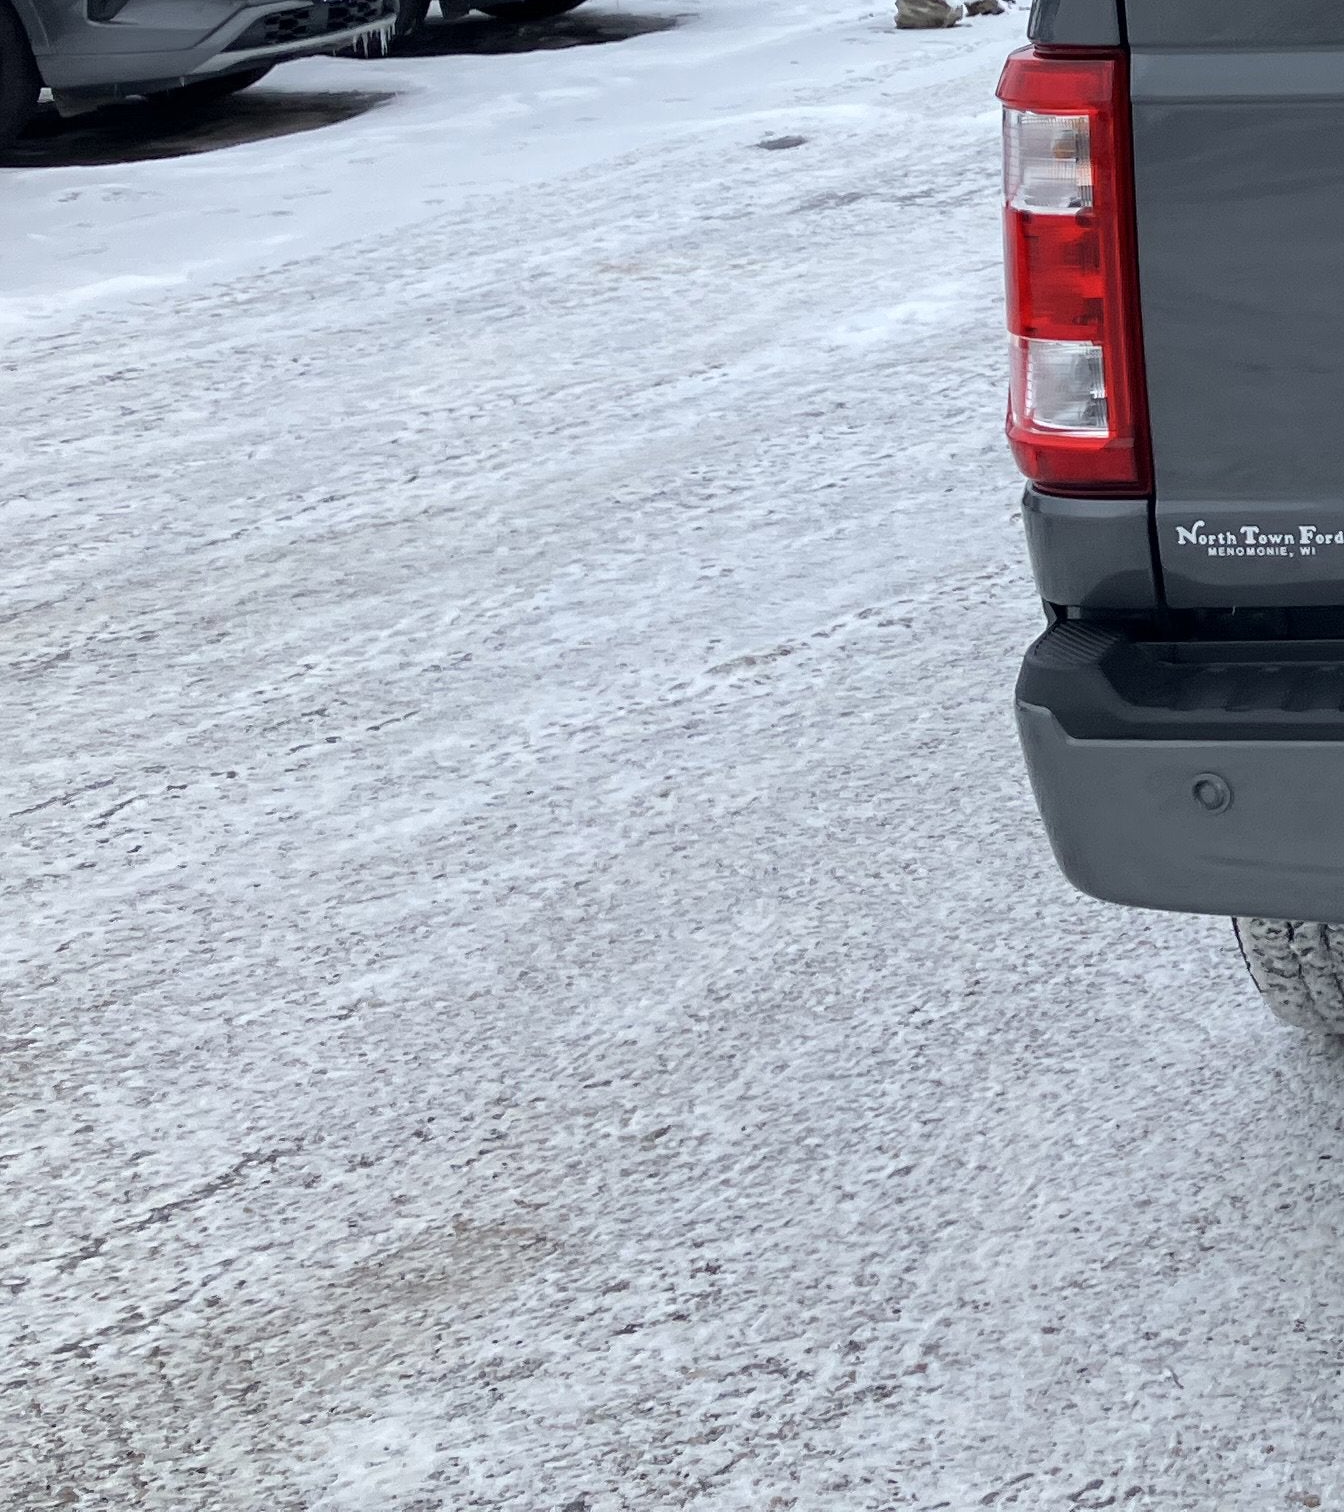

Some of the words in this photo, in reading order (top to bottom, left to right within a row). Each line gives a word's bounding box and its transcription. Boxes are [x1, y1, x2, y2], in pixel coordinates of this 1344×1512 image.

[1175, 520, 1238, 545] North
[1240, 525, 1295, 545] Town
[1298, 525, 1344, 545] Ford
[1207, 546, 1294, 558] MENOMONIE,
[1299, 546, 1317, 556] WI
